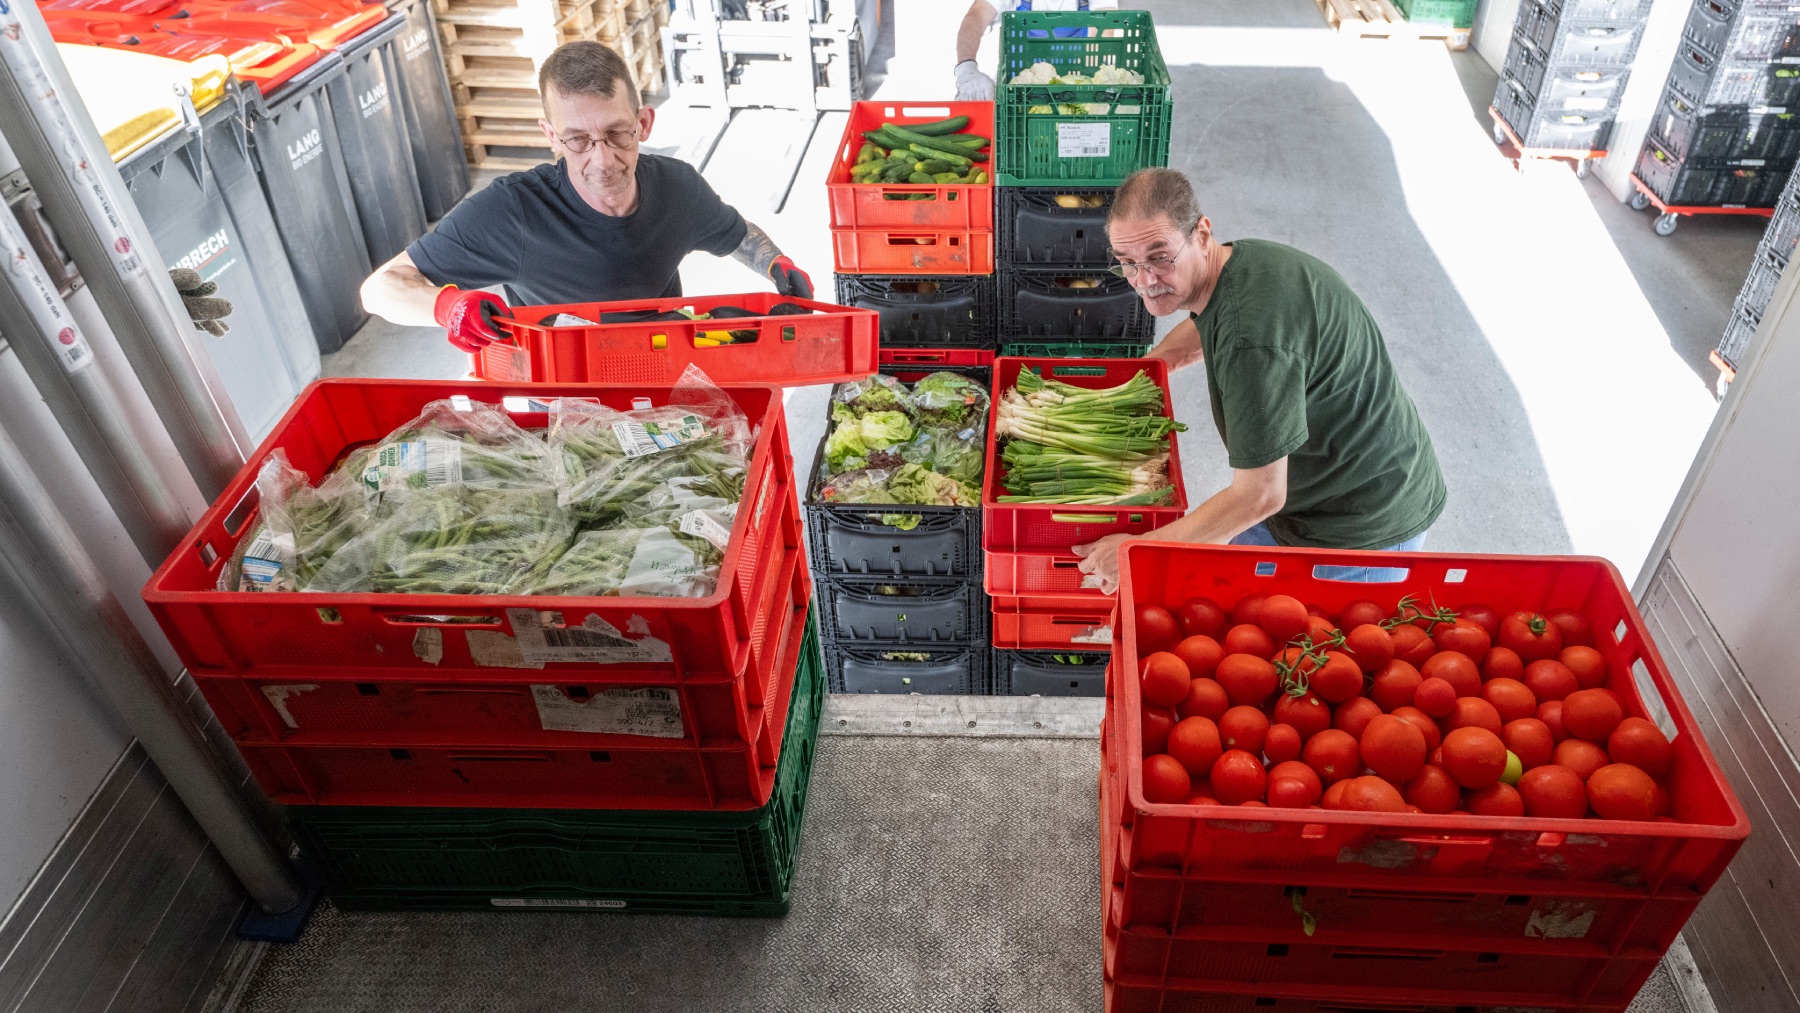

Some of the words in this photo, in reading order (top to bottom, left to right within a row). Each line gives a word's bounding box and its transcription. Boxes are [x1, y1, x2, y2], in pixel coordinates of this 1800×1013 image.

[359, 81, 388, 110] LANG
[287, 128, 321, 160] LANG
[291, 158, 303, 170] BIO
